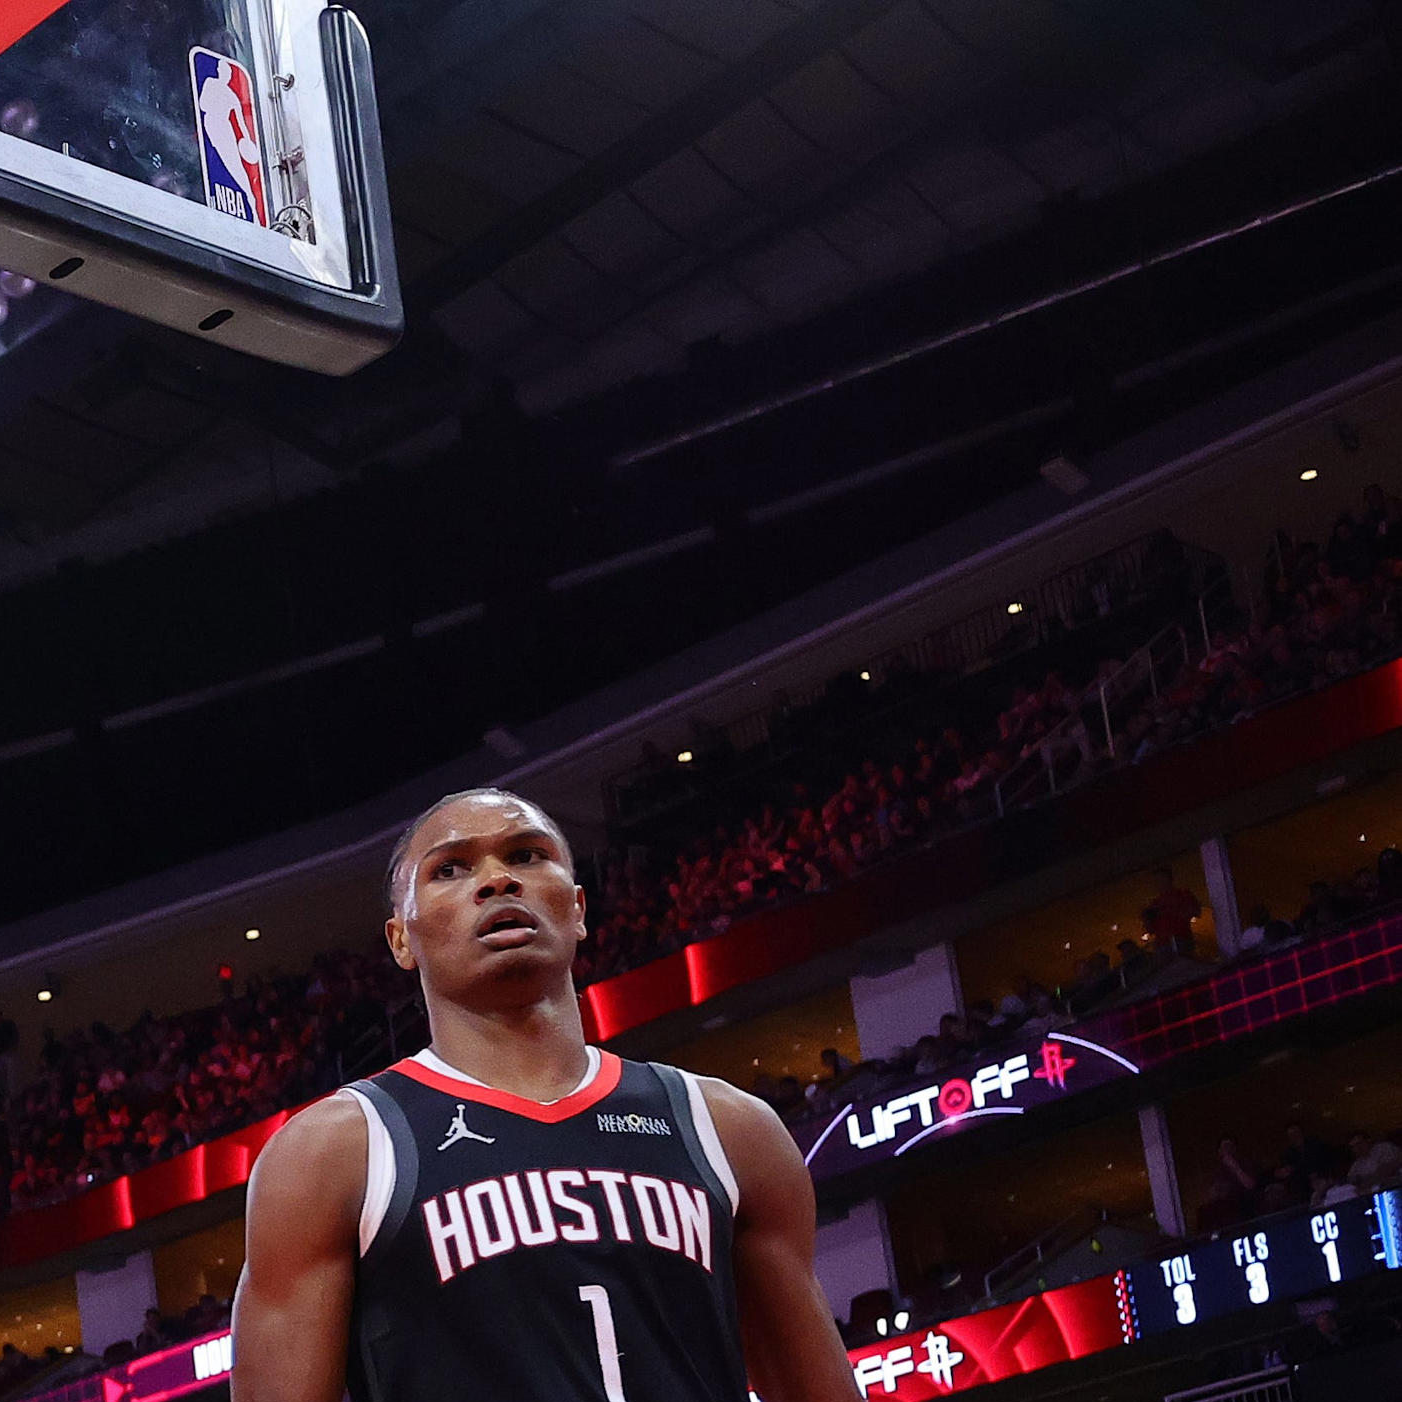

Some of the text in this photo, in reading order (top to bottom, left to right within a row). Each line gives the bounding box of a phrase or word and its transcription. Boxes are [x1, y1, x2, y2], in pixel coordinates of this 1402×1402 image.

[215, 183, 245, 218] NBA
[847, 1053, 1030, 1150] LIFTOFF
[421, 1168, 714, 1286] HOUSTON
[1159, 1211, 1339, 1287] TOL FLS CC
[1173, 1240, 1341, 1325] 3 3 1
